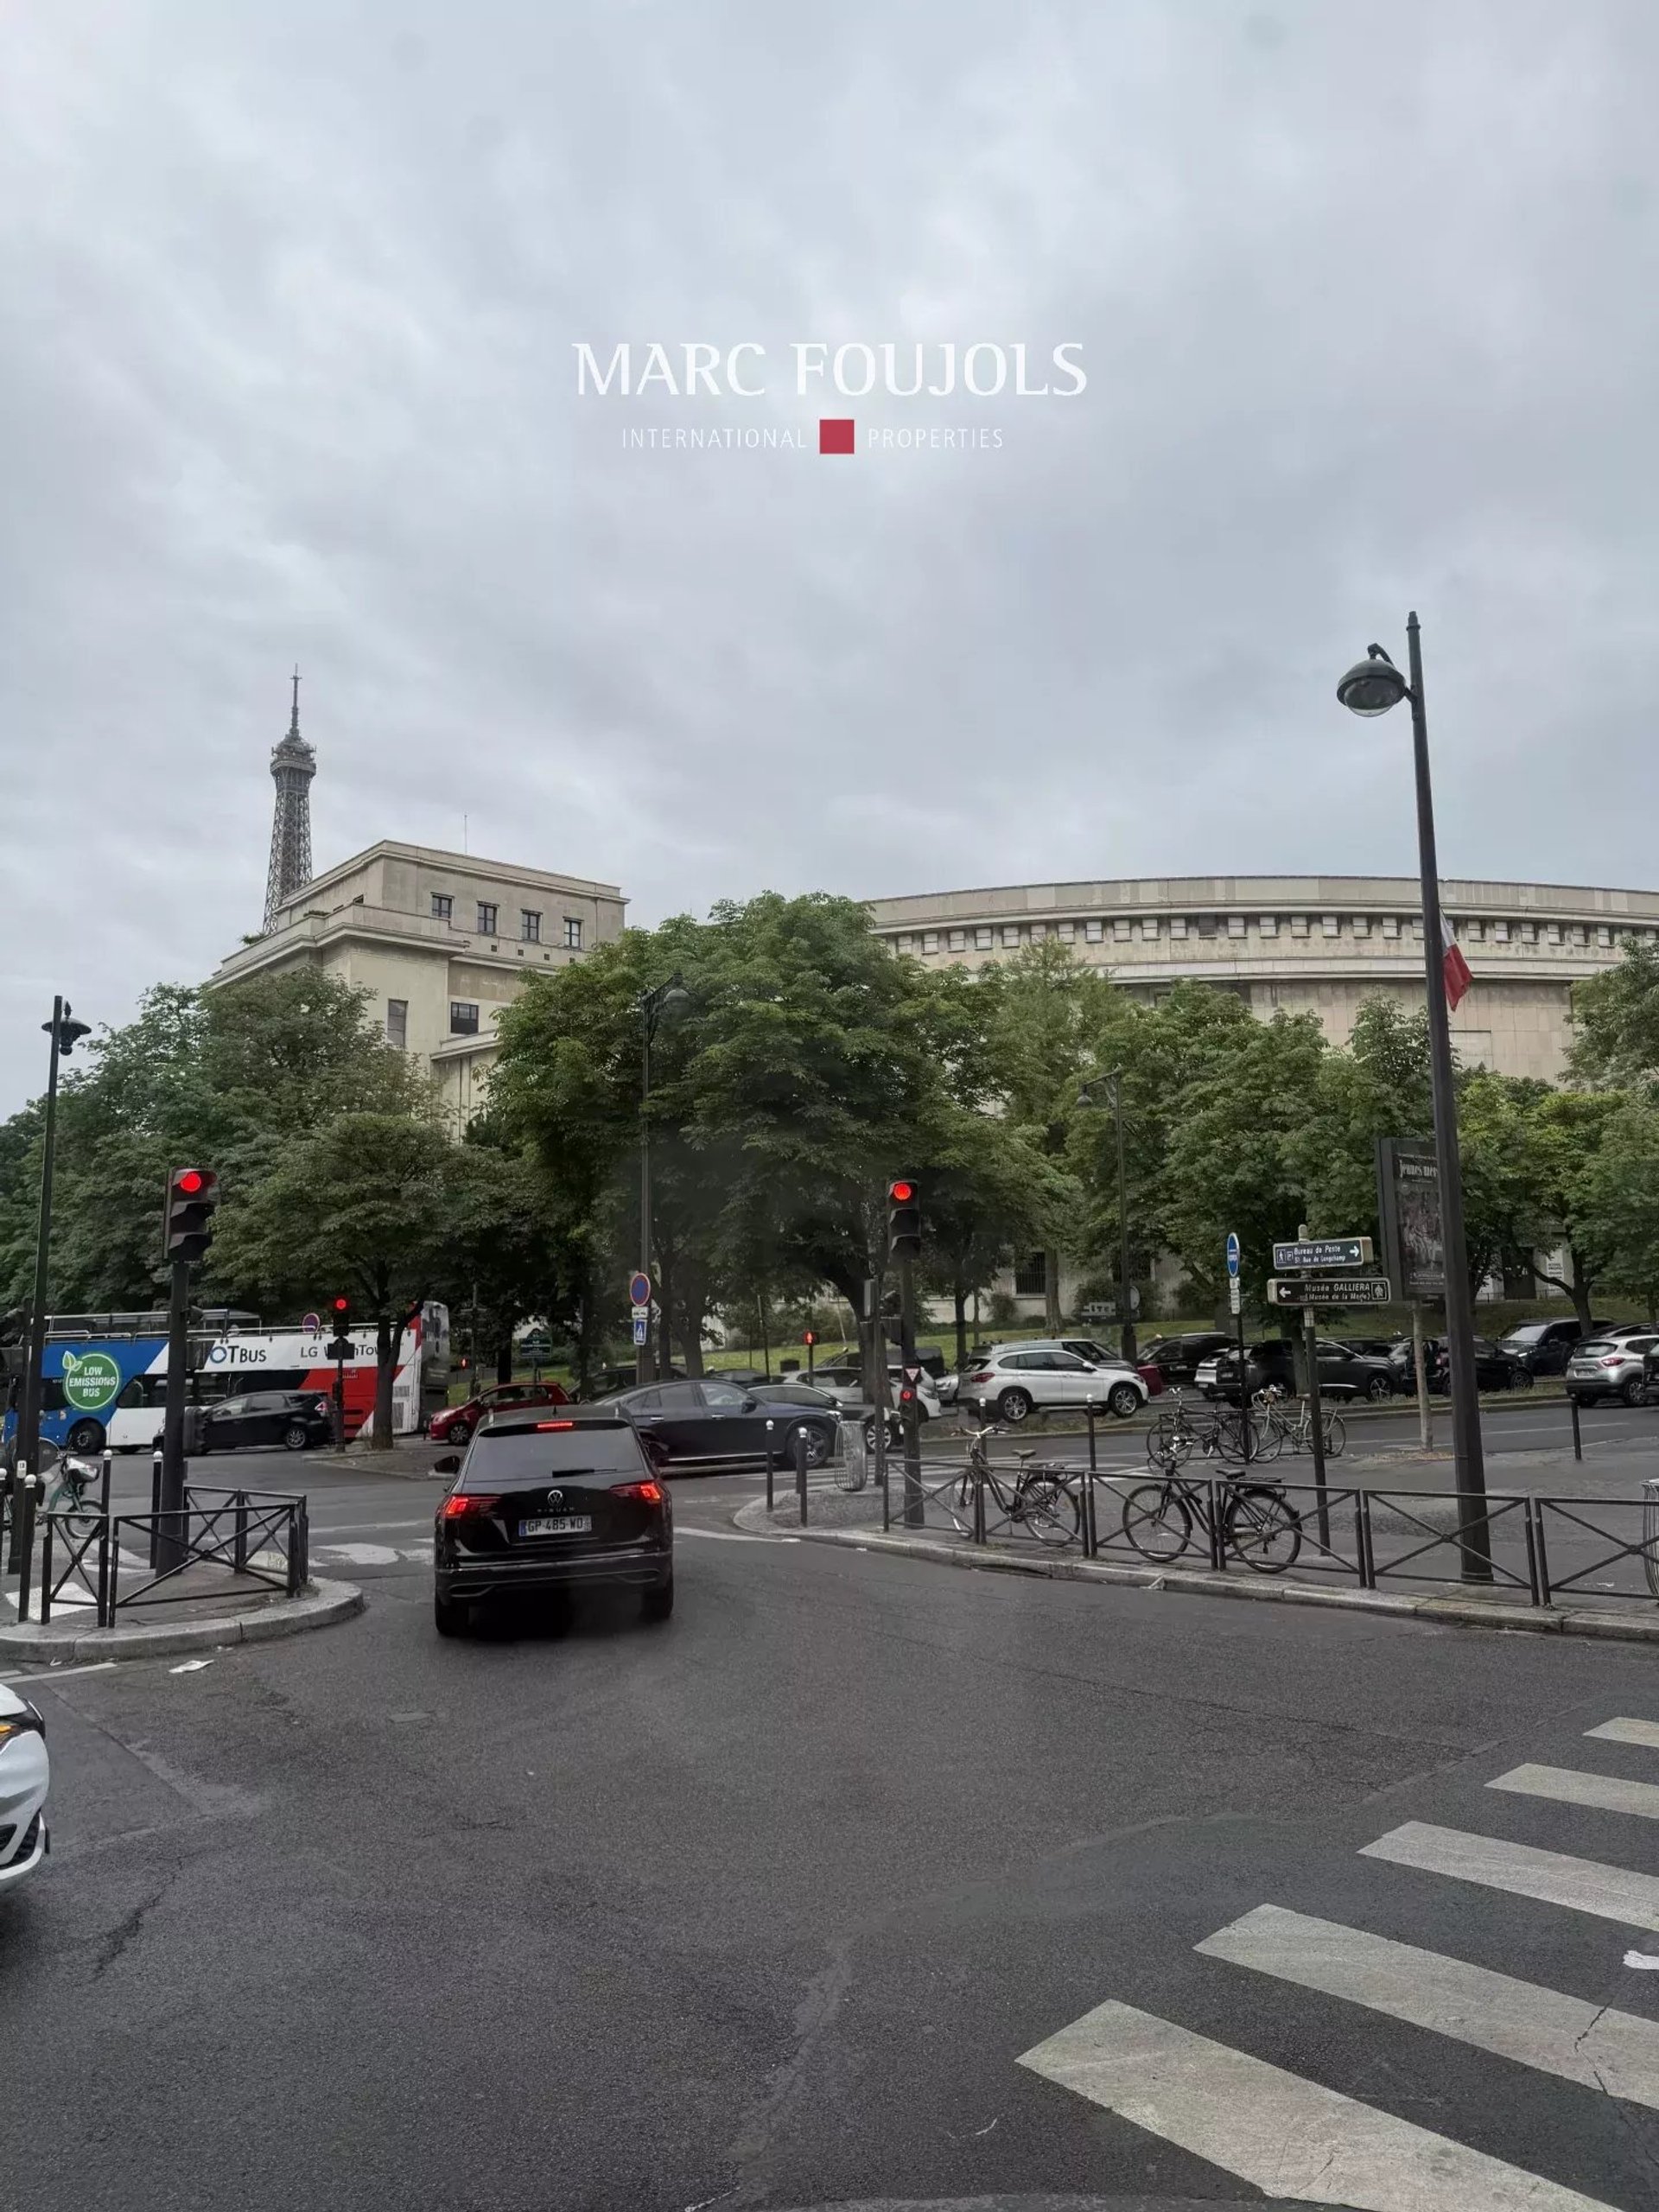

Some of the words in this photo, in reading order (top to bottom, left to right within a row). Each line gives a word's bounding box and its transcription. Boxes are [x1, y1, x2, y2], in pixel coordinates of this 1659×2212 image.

[1305, 1283, 1330, 1292] Musée
[1333, 1282, 1370, 1292] GALLIERA
[210, 1345, 267, 1363] OTBUS
[300, 1346, 318, 1357] LG
[84, 1366, 103, 1376] LOW
[69, 1376, 117, 1387] EMISSIONS
[83, 1388, 100, 1397] BUS
